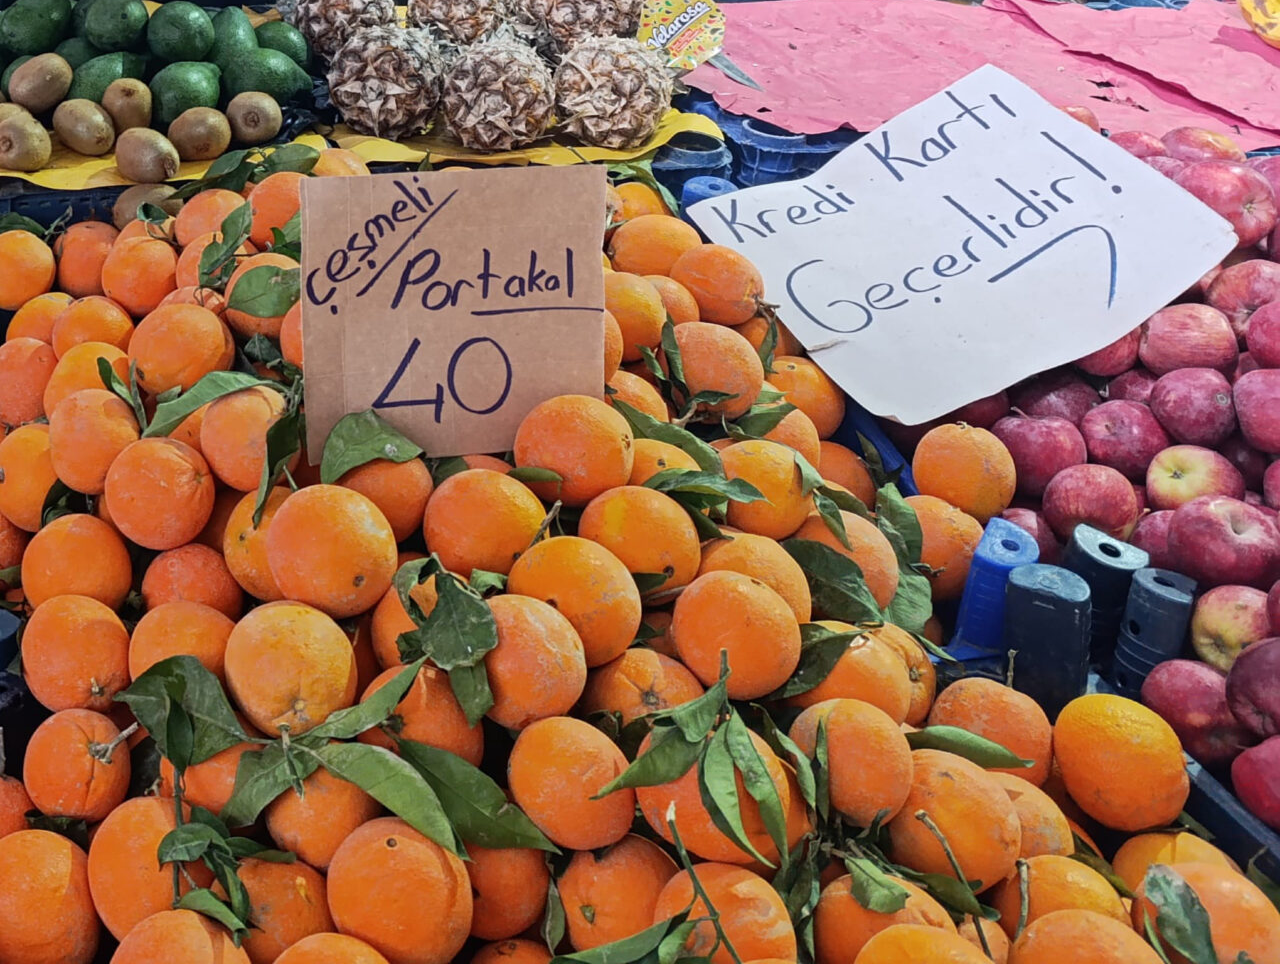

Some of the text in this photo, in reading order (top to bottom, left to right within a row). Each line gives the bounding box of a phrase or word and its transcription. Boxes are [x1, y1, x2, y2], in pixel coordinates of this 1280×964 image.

[646, 0, 711, 48] Velarosa
[710, 89, 1018, 243] Kredi Kartı
[391, 247, 574, 311] Portakal
[371, 336, 513, 424] 40
